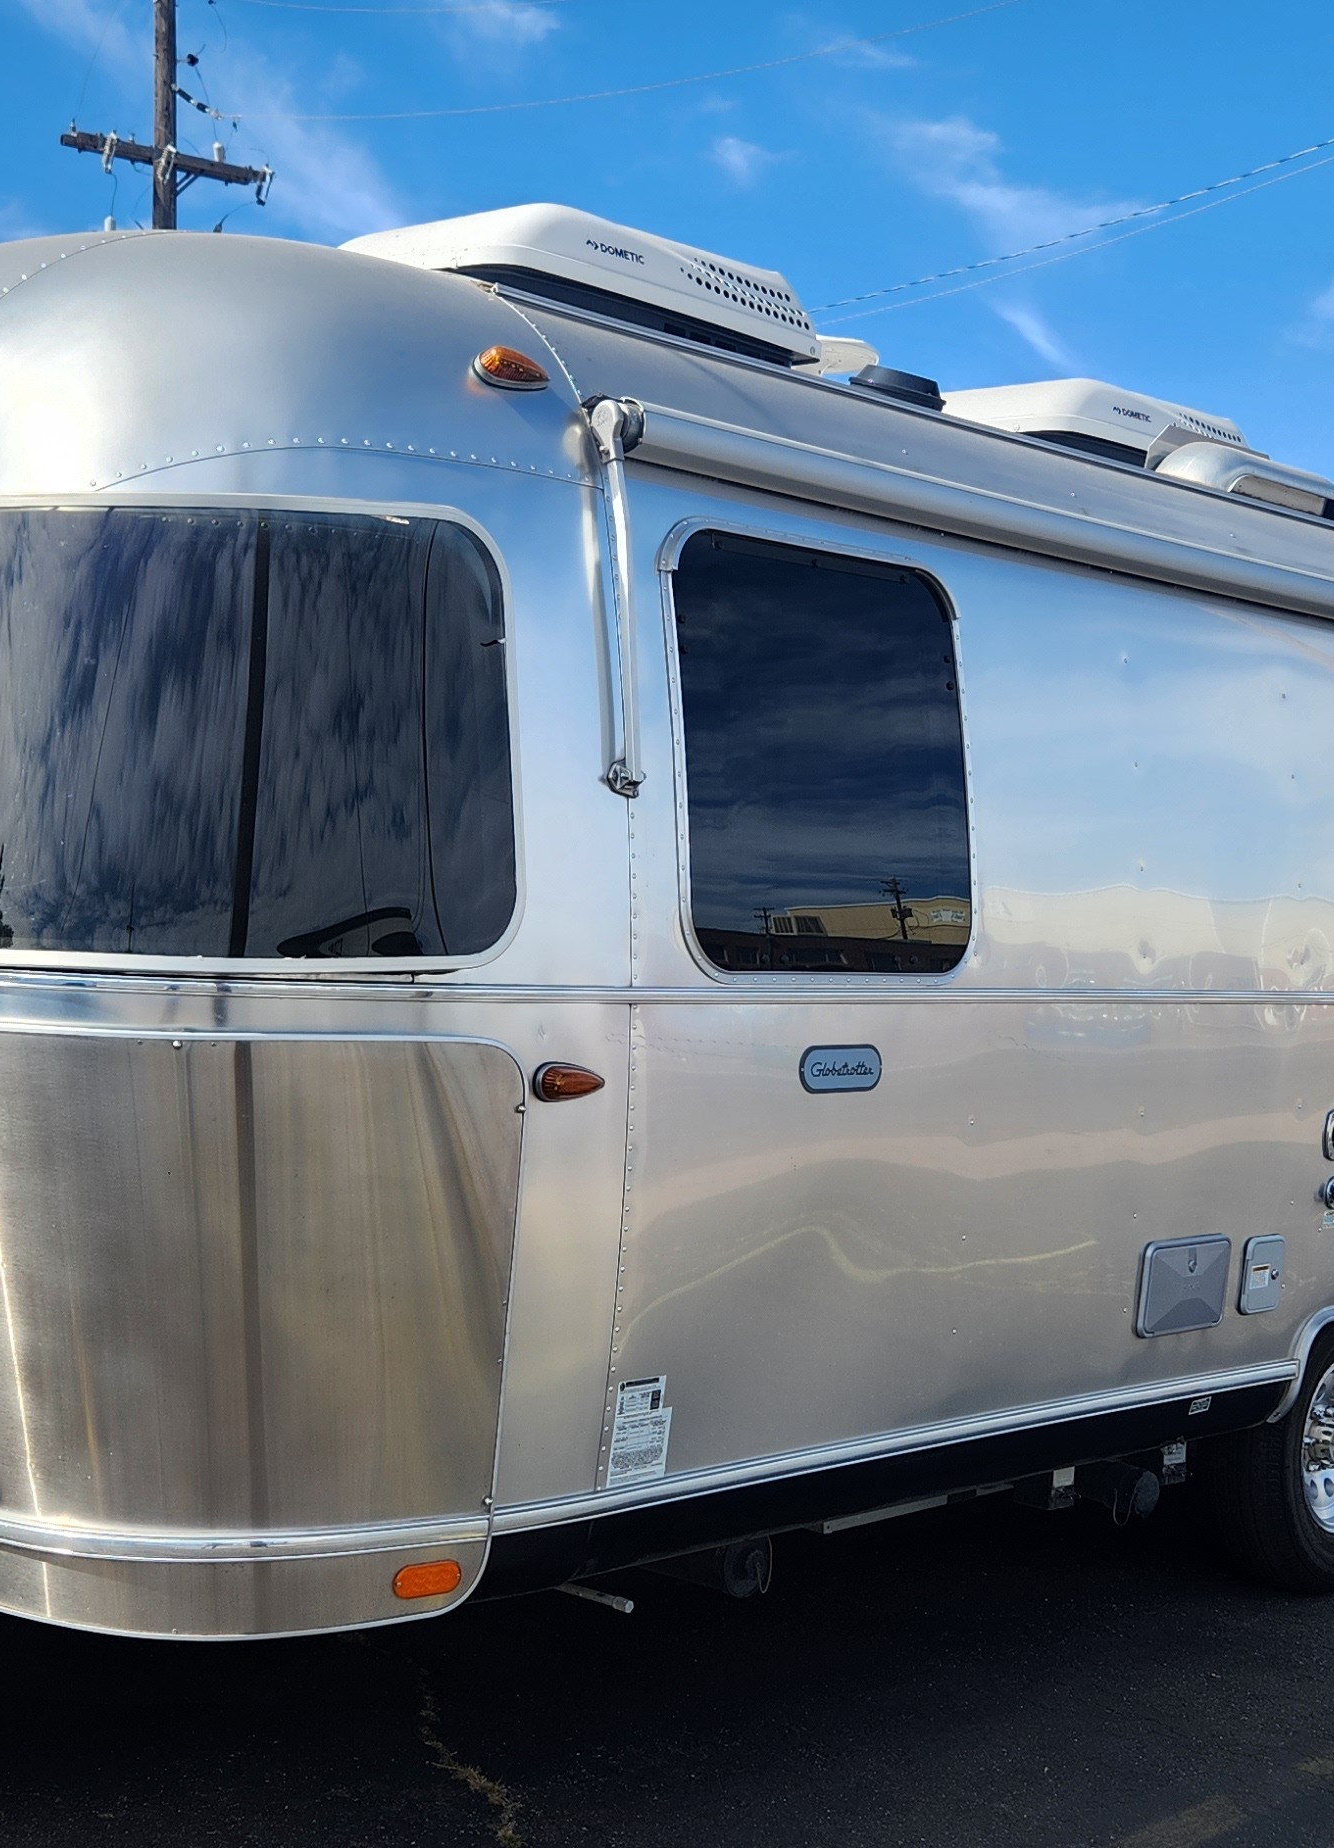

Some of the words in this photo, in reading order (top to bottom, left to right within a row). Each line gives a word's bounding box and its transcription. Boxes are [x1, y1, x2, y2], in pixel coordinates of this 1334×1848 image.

[599, 242, 645, 265] DOMETIC
[1121, 407, 1152, 423] DOMETIC
[810, 1061, 875, 1078] Globetrotter
